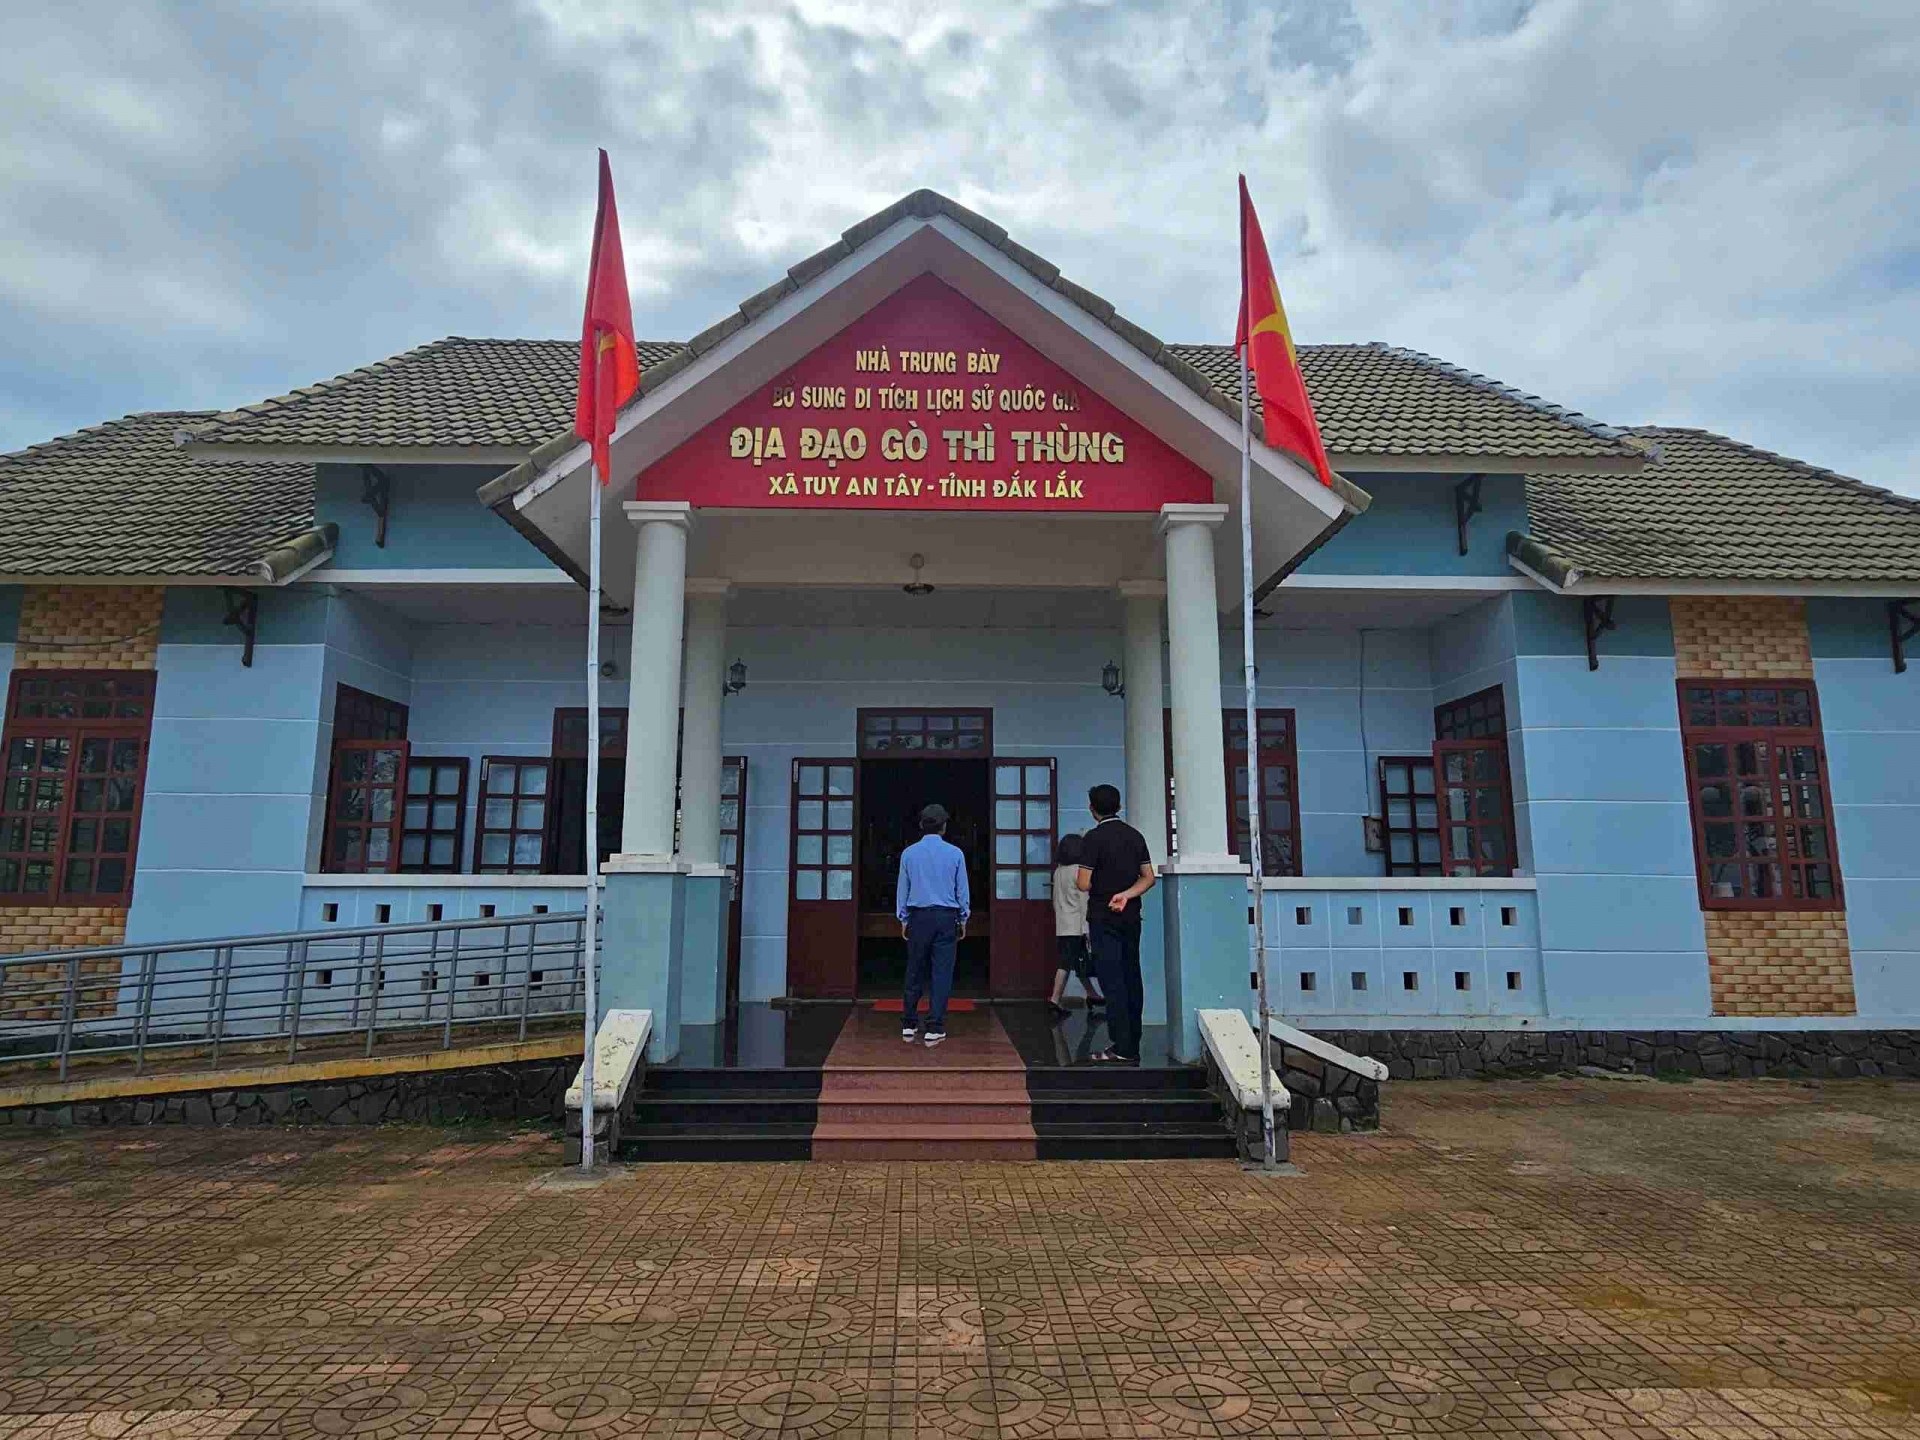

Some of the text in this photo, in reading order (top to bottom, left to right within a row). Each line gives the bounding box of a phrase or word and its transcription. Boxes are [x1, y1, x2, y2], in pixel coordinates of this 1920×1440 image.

[856, 345, 1000, 373] NHÀ TRƯNG BÀY
[801, 386, 846, 409] SUNG
[855, 387, 871, 409] DI
[878, 382, 918, 410] TÍCH
[927, 388, 964, 416] LỊCH
[1052, 388, 1080, 411] GIA
[730, 420, 1124, 468] ĐỊA ĐẠO GÒ THÌ THÙNG
[769, 472, 799, 495] XÃ
[803, 476, 841, 496] TUY
[845, 477, 878, 496] AN
[884, 472, 923, 497] TÂY
[939, 471, 986, 498] TỈNH
[993, 469, 1037, 498] ĐẮK
[1045, 469, 1084, 498] LẮK
